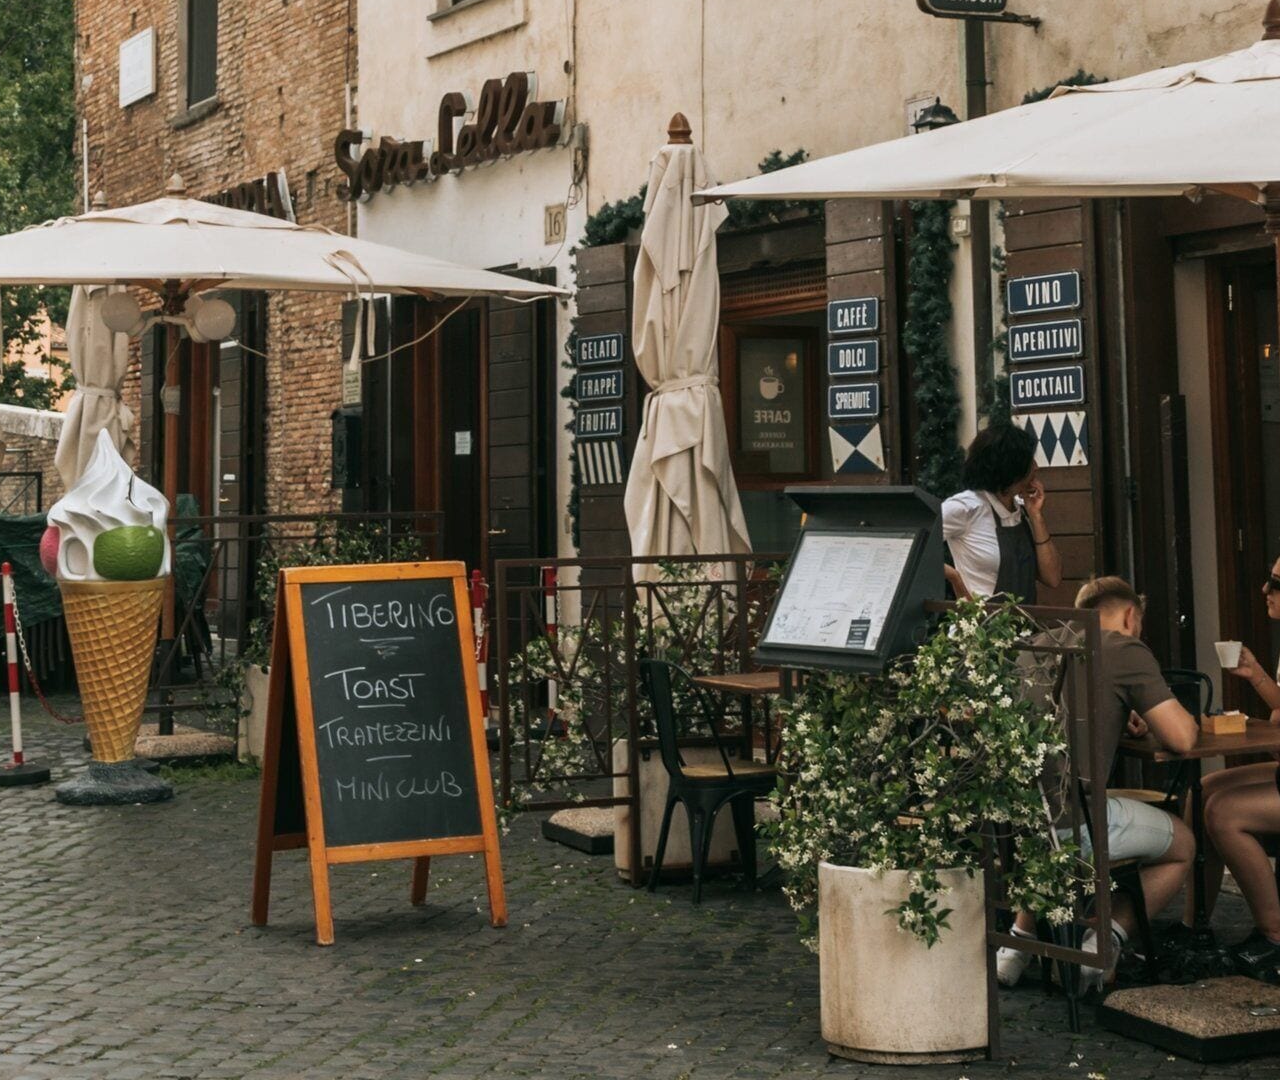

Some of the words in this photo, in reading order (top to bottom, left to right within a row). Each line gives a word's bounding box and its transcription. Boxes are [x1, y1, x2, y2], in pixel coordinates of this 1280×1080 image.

[429, 71, 562, 176] Lella
[548, 211, 562, 237] 16
[1025, 280, 1061, 306] VINO
[837, 303, 868, 328] CAFFÈ
[581, 339, 617, 360] GELATO
[1014, 327, 1077, 353] APERITIVI
[839, 348, 866, 368] DOLCI
[582, 374, 617, 397] FRAPPÈ
[1018, 375, 1075, 398] COCKTAIL
[835, 391, 870, 410] SPREMUTE
[580, 411, 617, 432] FRUTTA
[310, 586, 455, 629] TIBERINO
[324, 666, 426, 700] TOAST
[318, 714, 451, 749] TRAMEZZINI
